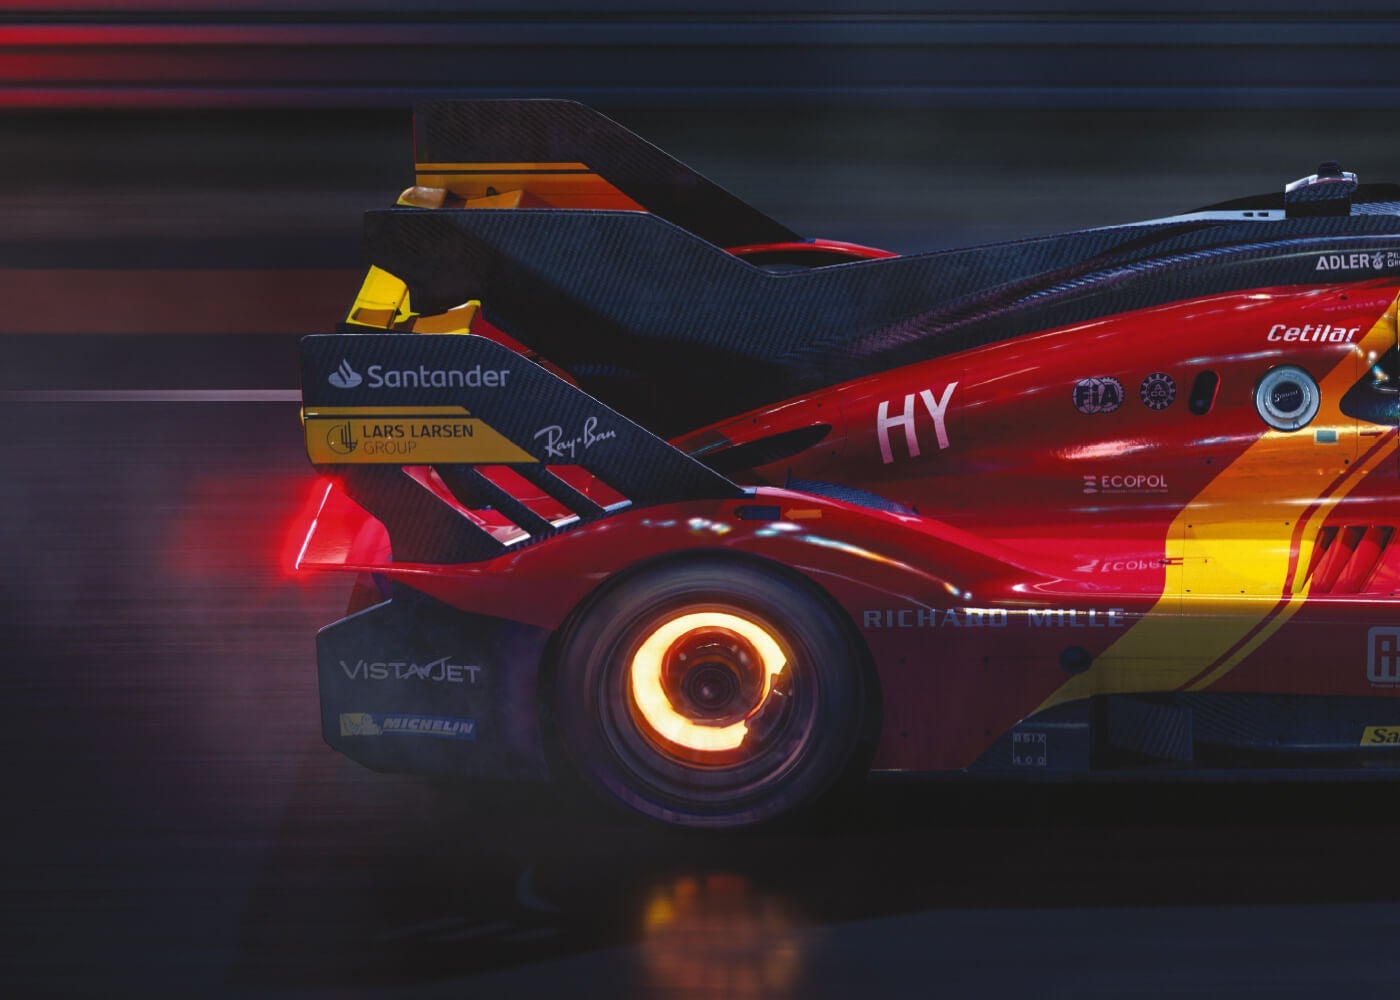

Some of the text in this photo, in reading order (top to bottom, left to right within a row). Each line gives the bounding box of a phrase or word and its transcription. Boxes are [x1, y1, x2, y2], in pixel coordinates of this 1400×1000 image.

[1316, 254, 1370, 270] ADLER
[1267, 324, 1361, 342] Cetilar
[368, 365, 510, 388] Santander
[363, 424, 474, 438] LARS LARSEN
[877, 382, 958, 464] HY
[363, 441, 416, 454] GROUP
[1102, 475, 1167, 488] ECOPOL
[864, 608, 1124, 628] RICHARD MILLE
[383, 718, 474, 734] MICHELIN
